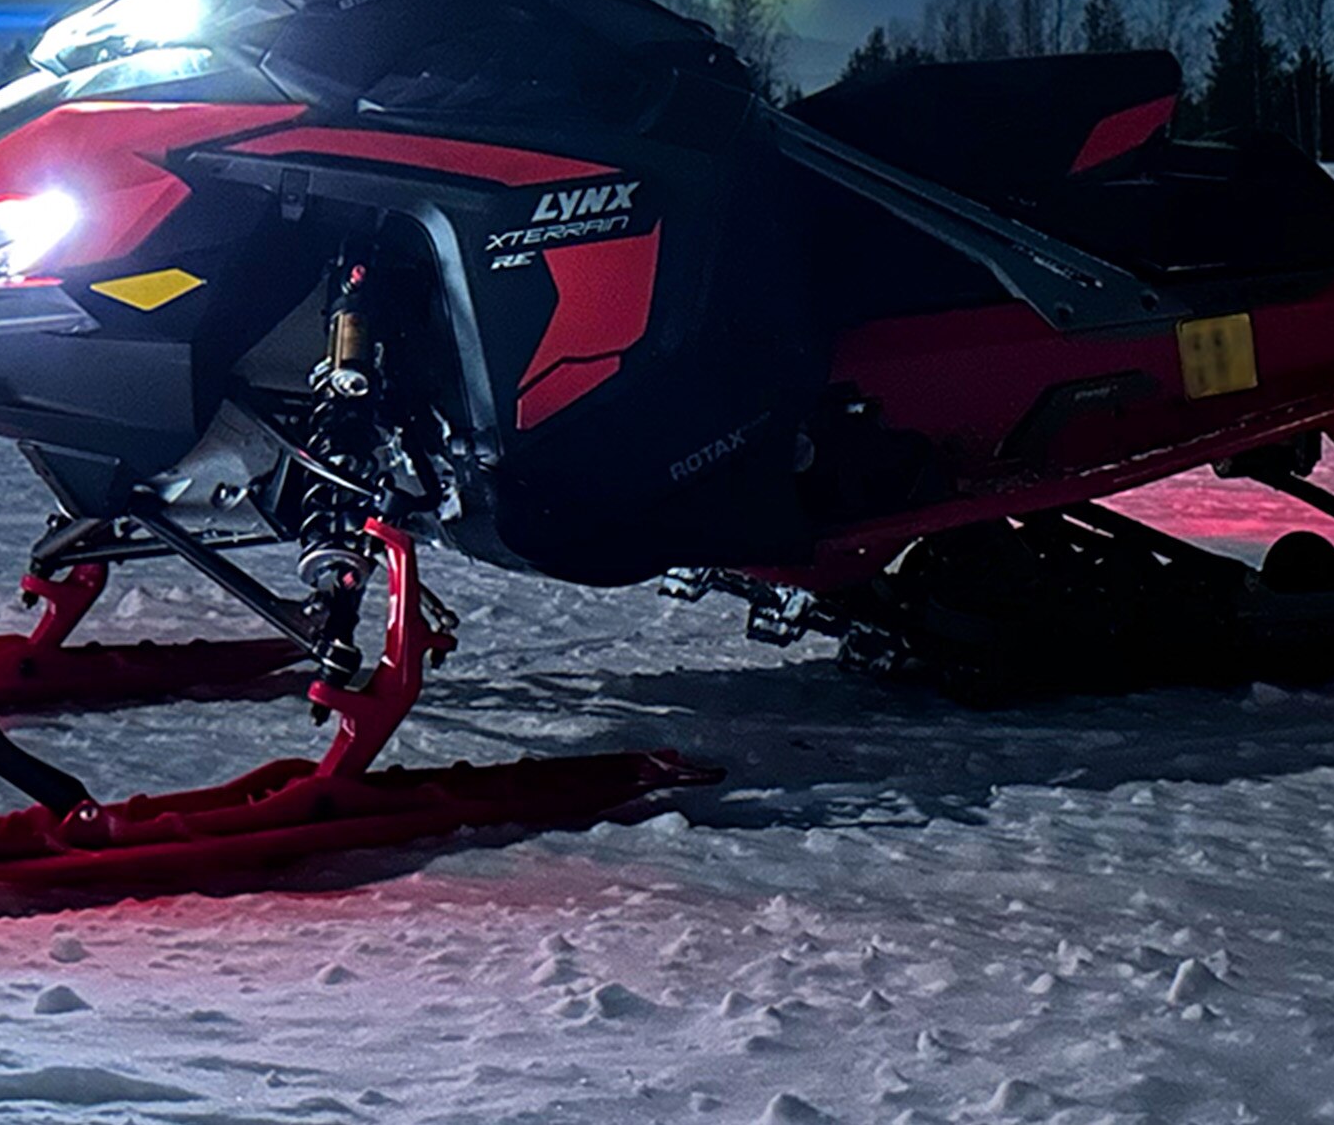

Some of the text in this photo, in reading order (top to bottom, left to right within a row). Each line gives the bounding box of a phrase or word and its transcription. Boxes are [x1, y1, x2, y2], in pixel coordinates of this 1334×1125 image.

[531, 181, 641, 222] LYNX
[485, 215, 629, 251] XTERRAIN
[669, 428, 746, 481] ROTAX
